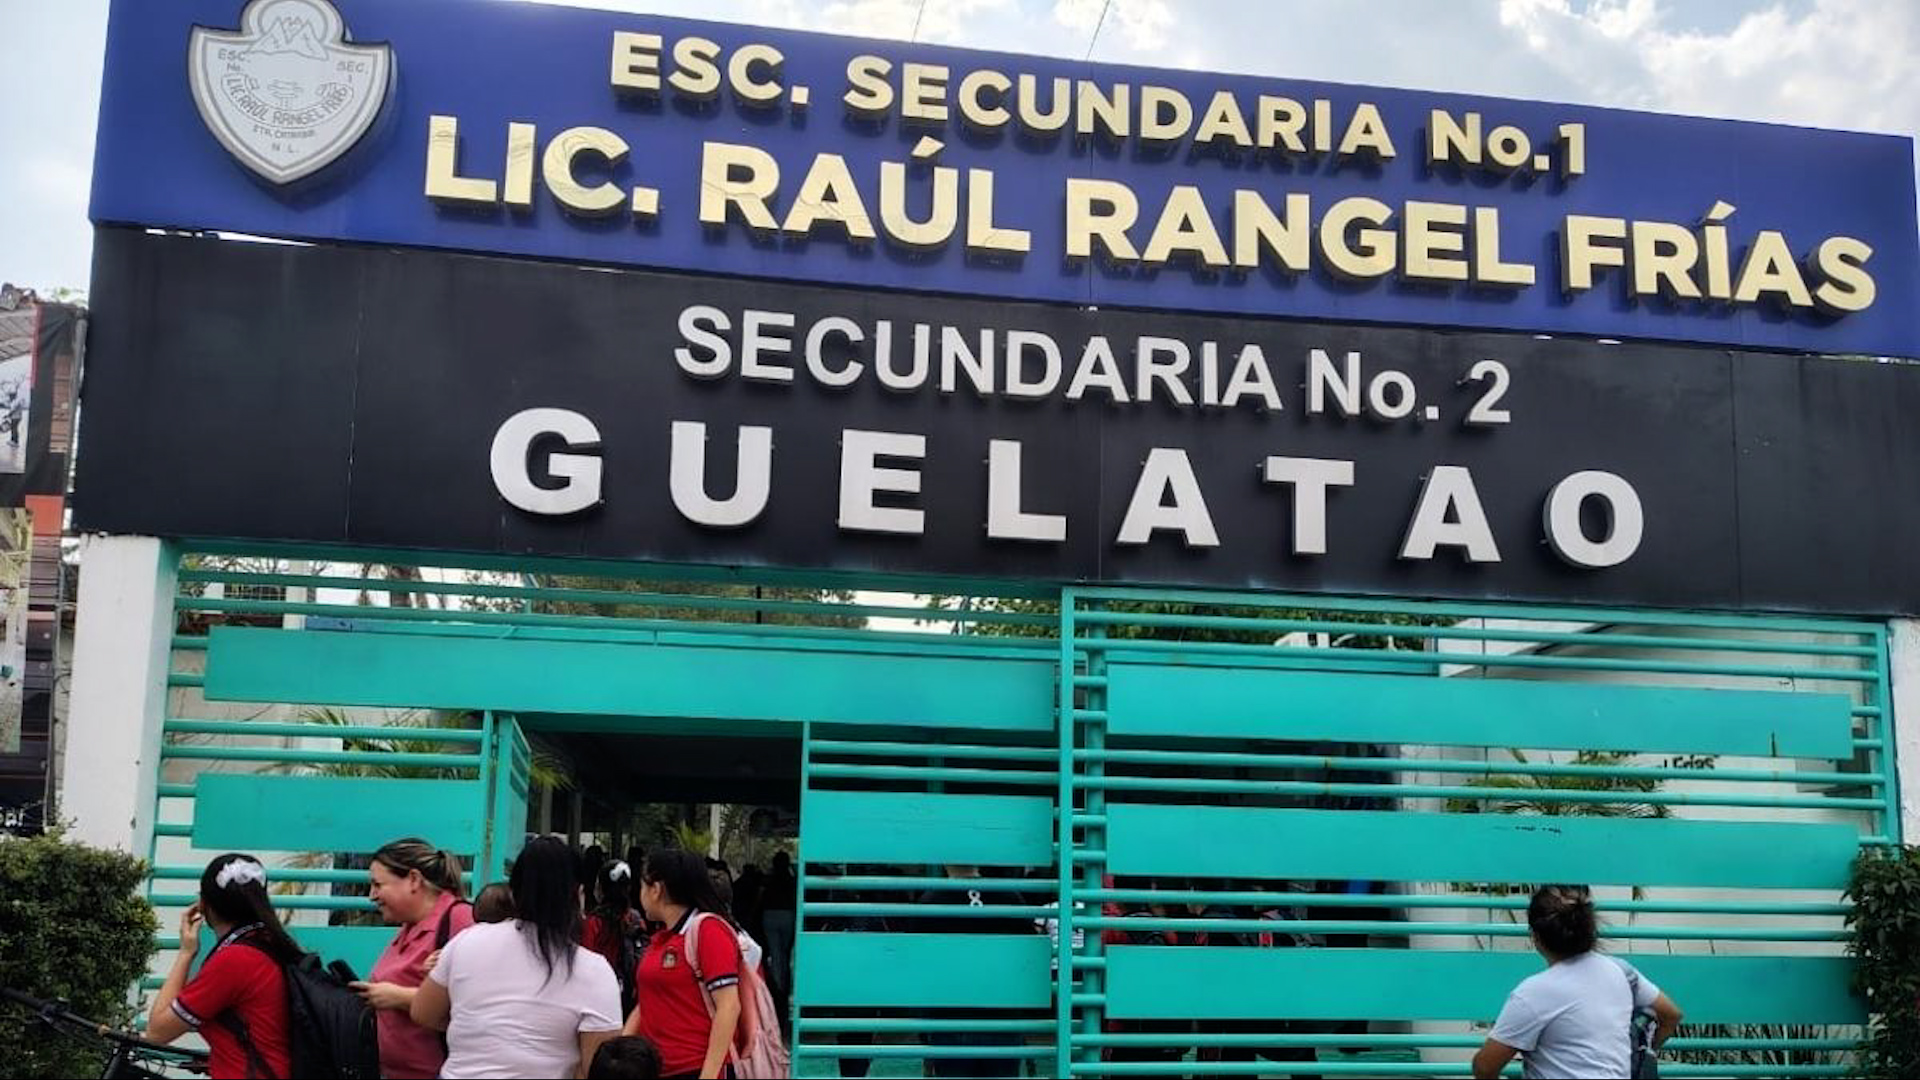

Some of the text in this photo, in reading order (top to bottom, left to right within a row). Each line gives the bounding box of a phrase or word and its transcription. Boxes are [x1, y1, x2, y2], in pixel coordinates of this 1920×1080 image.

[611, 30, 810, 107] ESC.
[843, 54, 1396, 160] SECUNDARIA
[424, 114, 1878, 314] LIC. RAÚL RANGEL FRÍAS
[674, 304, 1512, 425] SECUNDARIA No. 2
[489, 406, 1645, 569] GUELATAO
